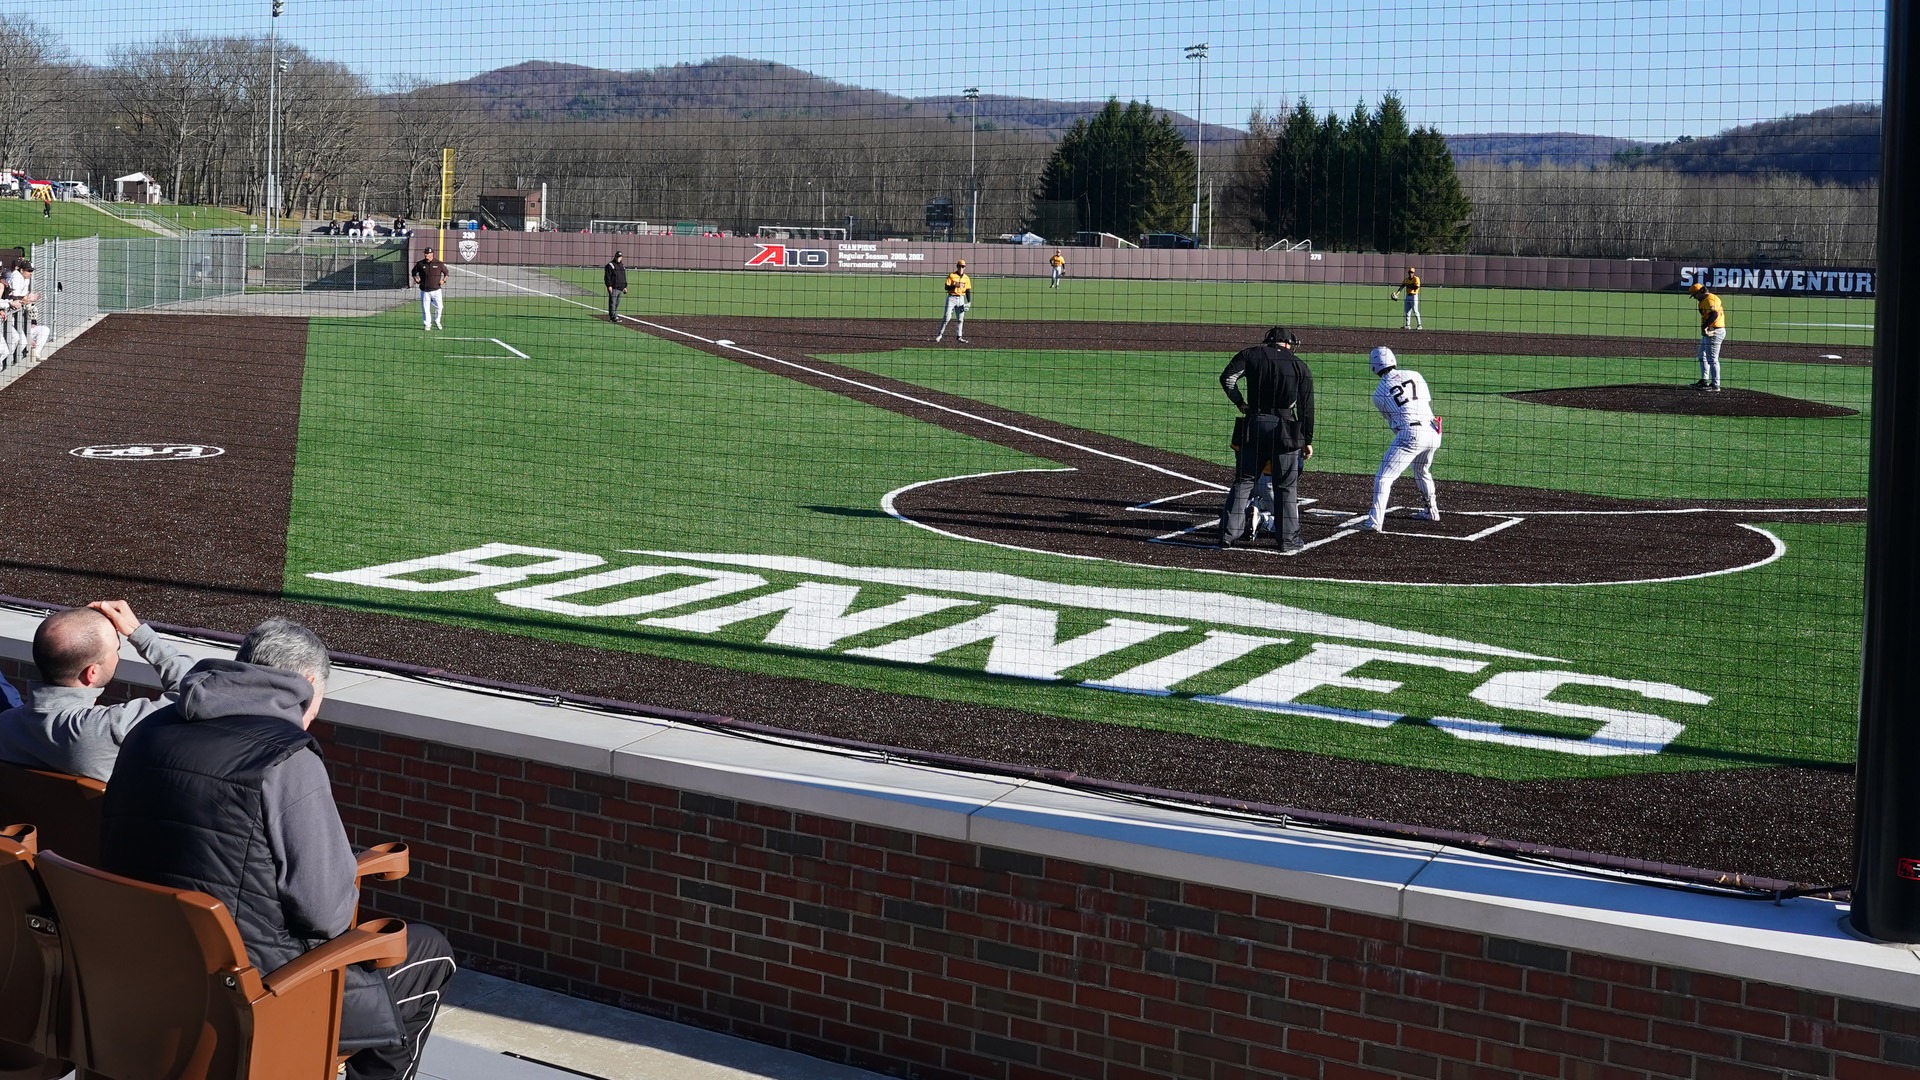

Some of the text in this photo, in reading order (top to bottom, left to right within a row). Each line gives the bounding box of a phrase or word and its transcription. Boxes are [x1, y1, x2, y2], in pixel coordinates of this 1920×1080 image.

[462, 231, 475, 239] 330
[744, 243, 829, 267] A10
[838, 243, 877, 252] CHAMPIONS
[838, 252, 865, 261] Regular
[838, 260, 879, 268] Tournament
[1712, 267, 1877, 292] BONAVENTUR
[1389, 379, 1419, 407] 27
[305, 541, 1715, 757] BONNIES
